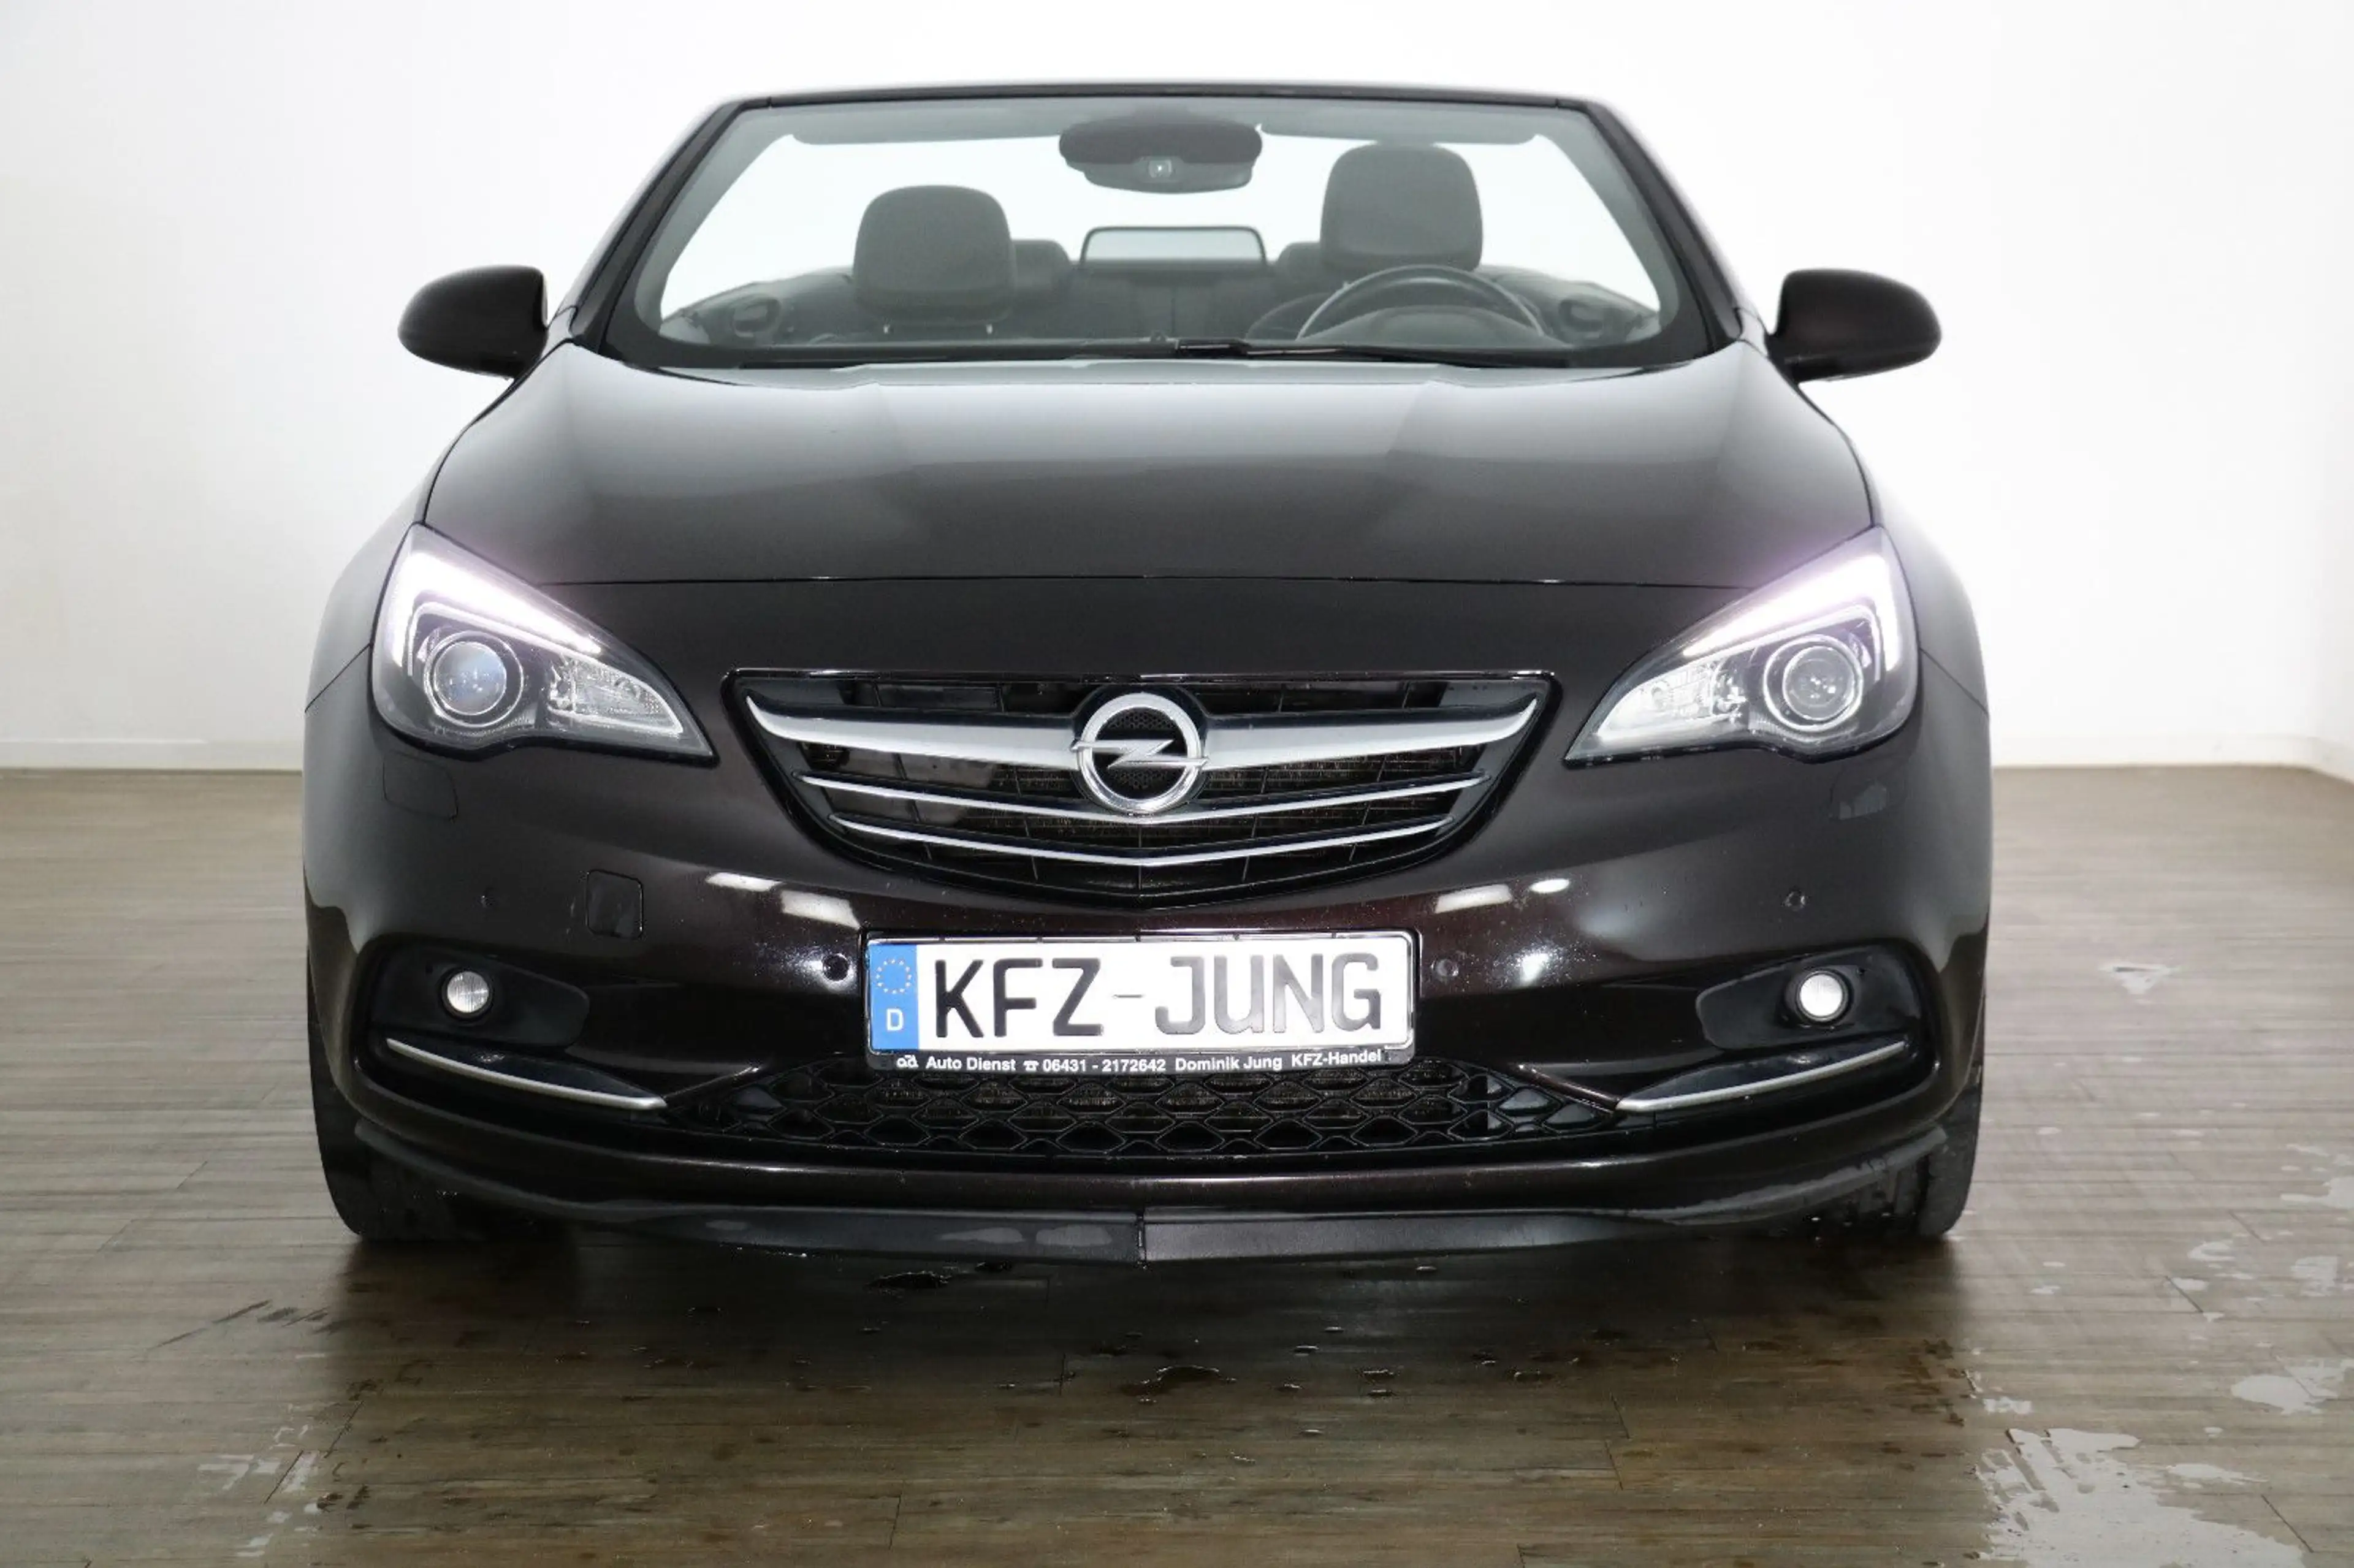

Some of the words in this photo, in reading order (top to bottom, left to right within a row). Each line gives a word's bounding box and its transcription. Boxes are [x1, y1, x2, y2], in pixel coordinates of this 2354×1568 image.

[886, 1008, 904, 1031] D
[925, 1056, 962, 1070] Auto
[966, 1056, 1016, 1071] Dienst
[1042, 1059, 1086, 1072] 06431
[1101, 1058, 1167, 1072] 2172642
[1175, 1056, 1240, 1071] Dominik
[1243, 1056, 1282, 1071] Jung
[1291, 1048, 1381, 1068] KFZ-Handel
